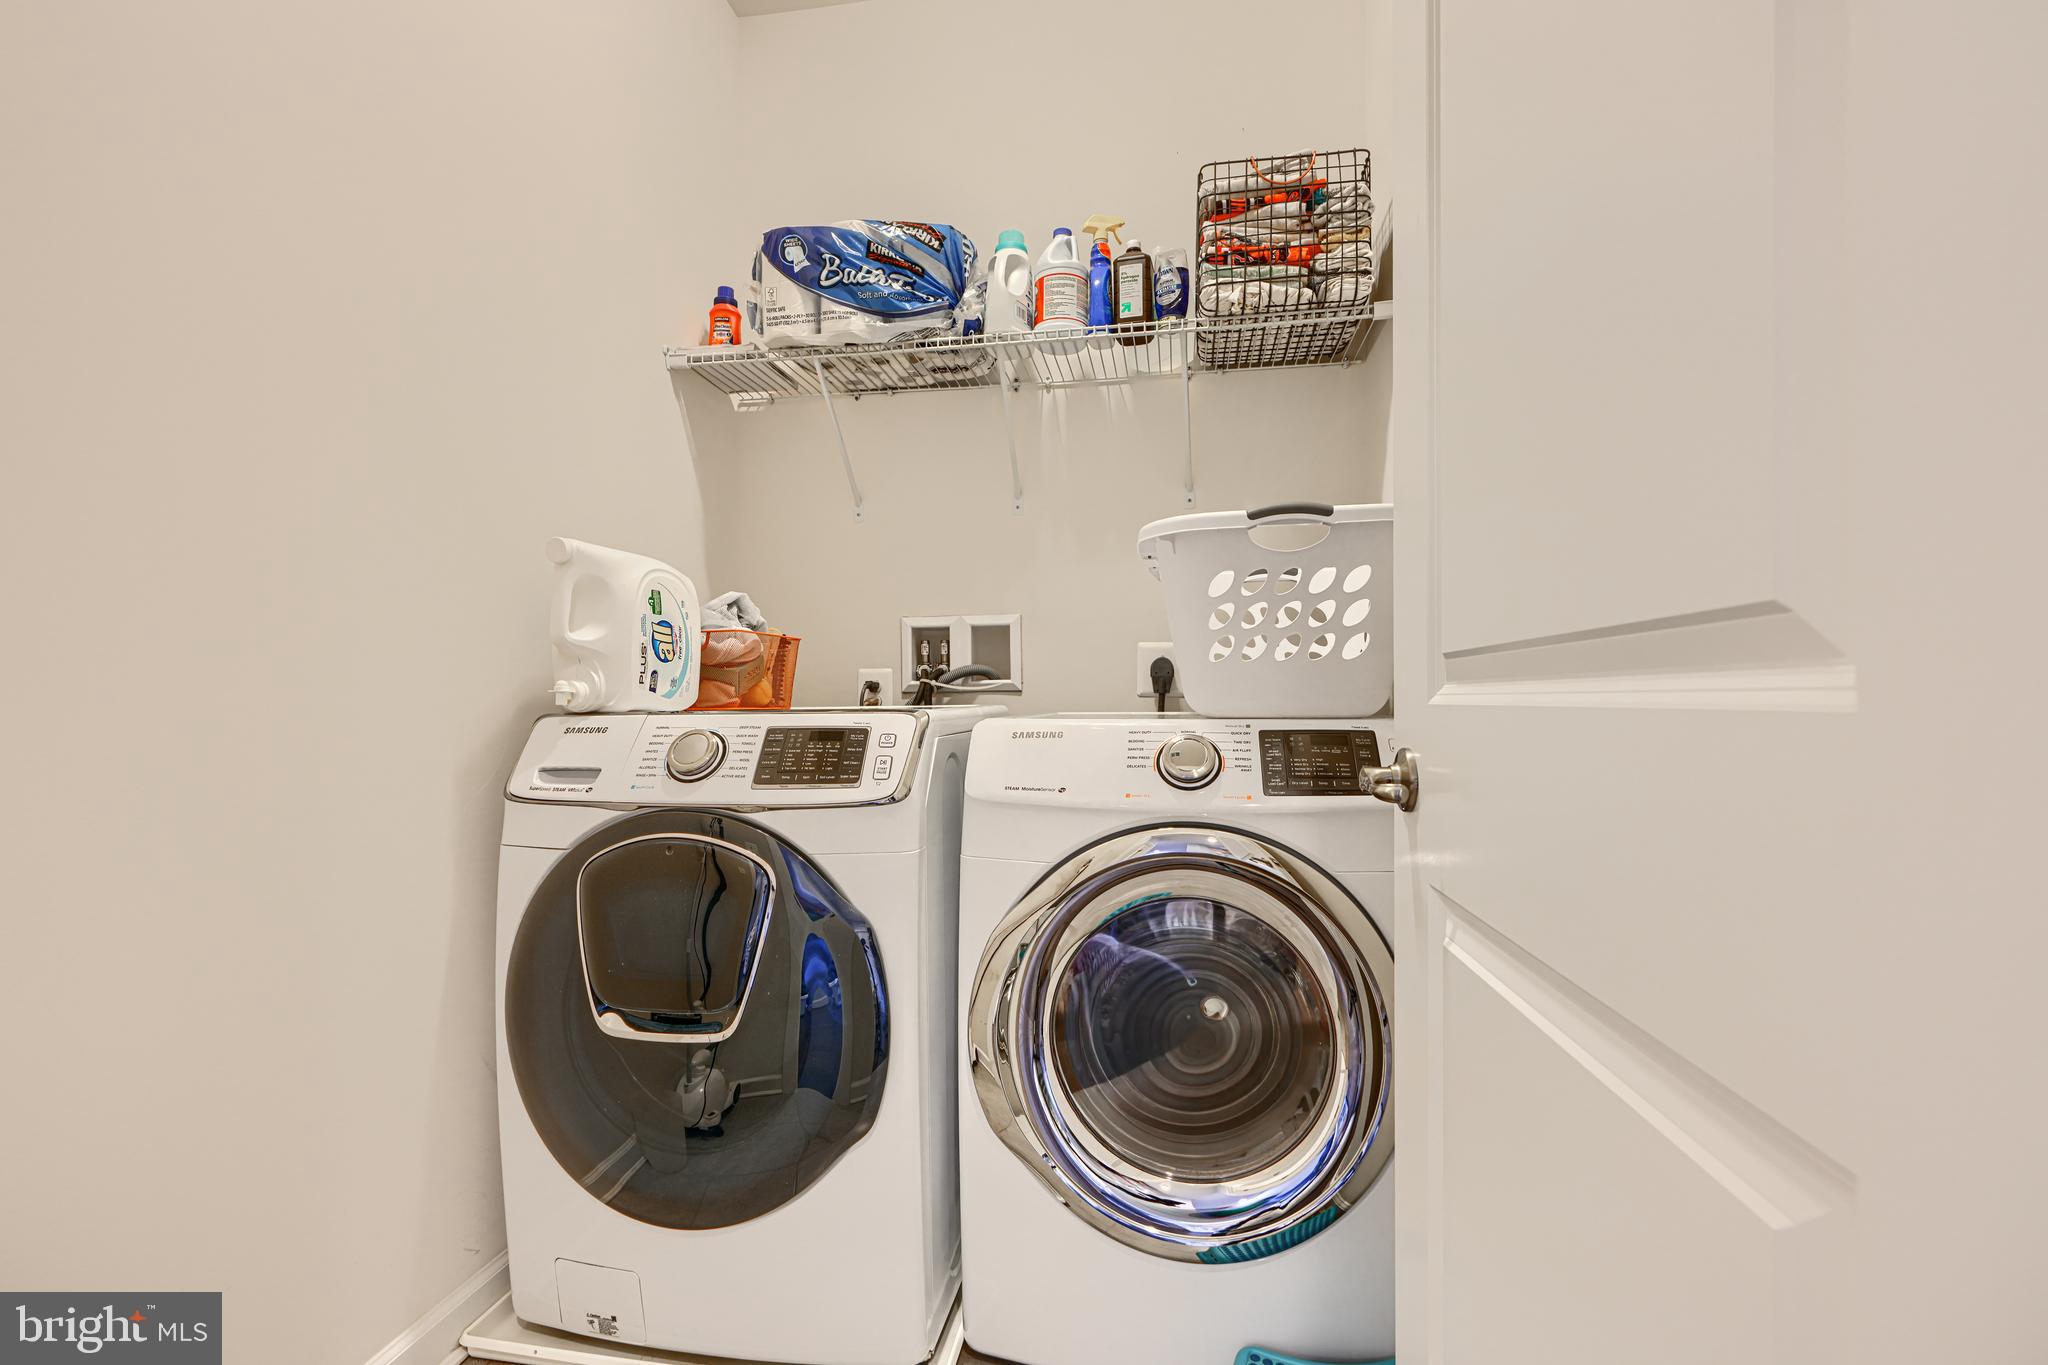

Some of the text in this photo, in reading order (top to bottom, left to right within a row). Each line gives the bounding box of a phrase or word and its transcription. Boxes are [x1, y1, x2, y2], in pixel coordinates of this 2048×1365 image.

[651, 621, 675, 663] all
[563, 727, 609, 735] SAMSUNG
[1011, 731, 1064, 739] SAMSUNG
